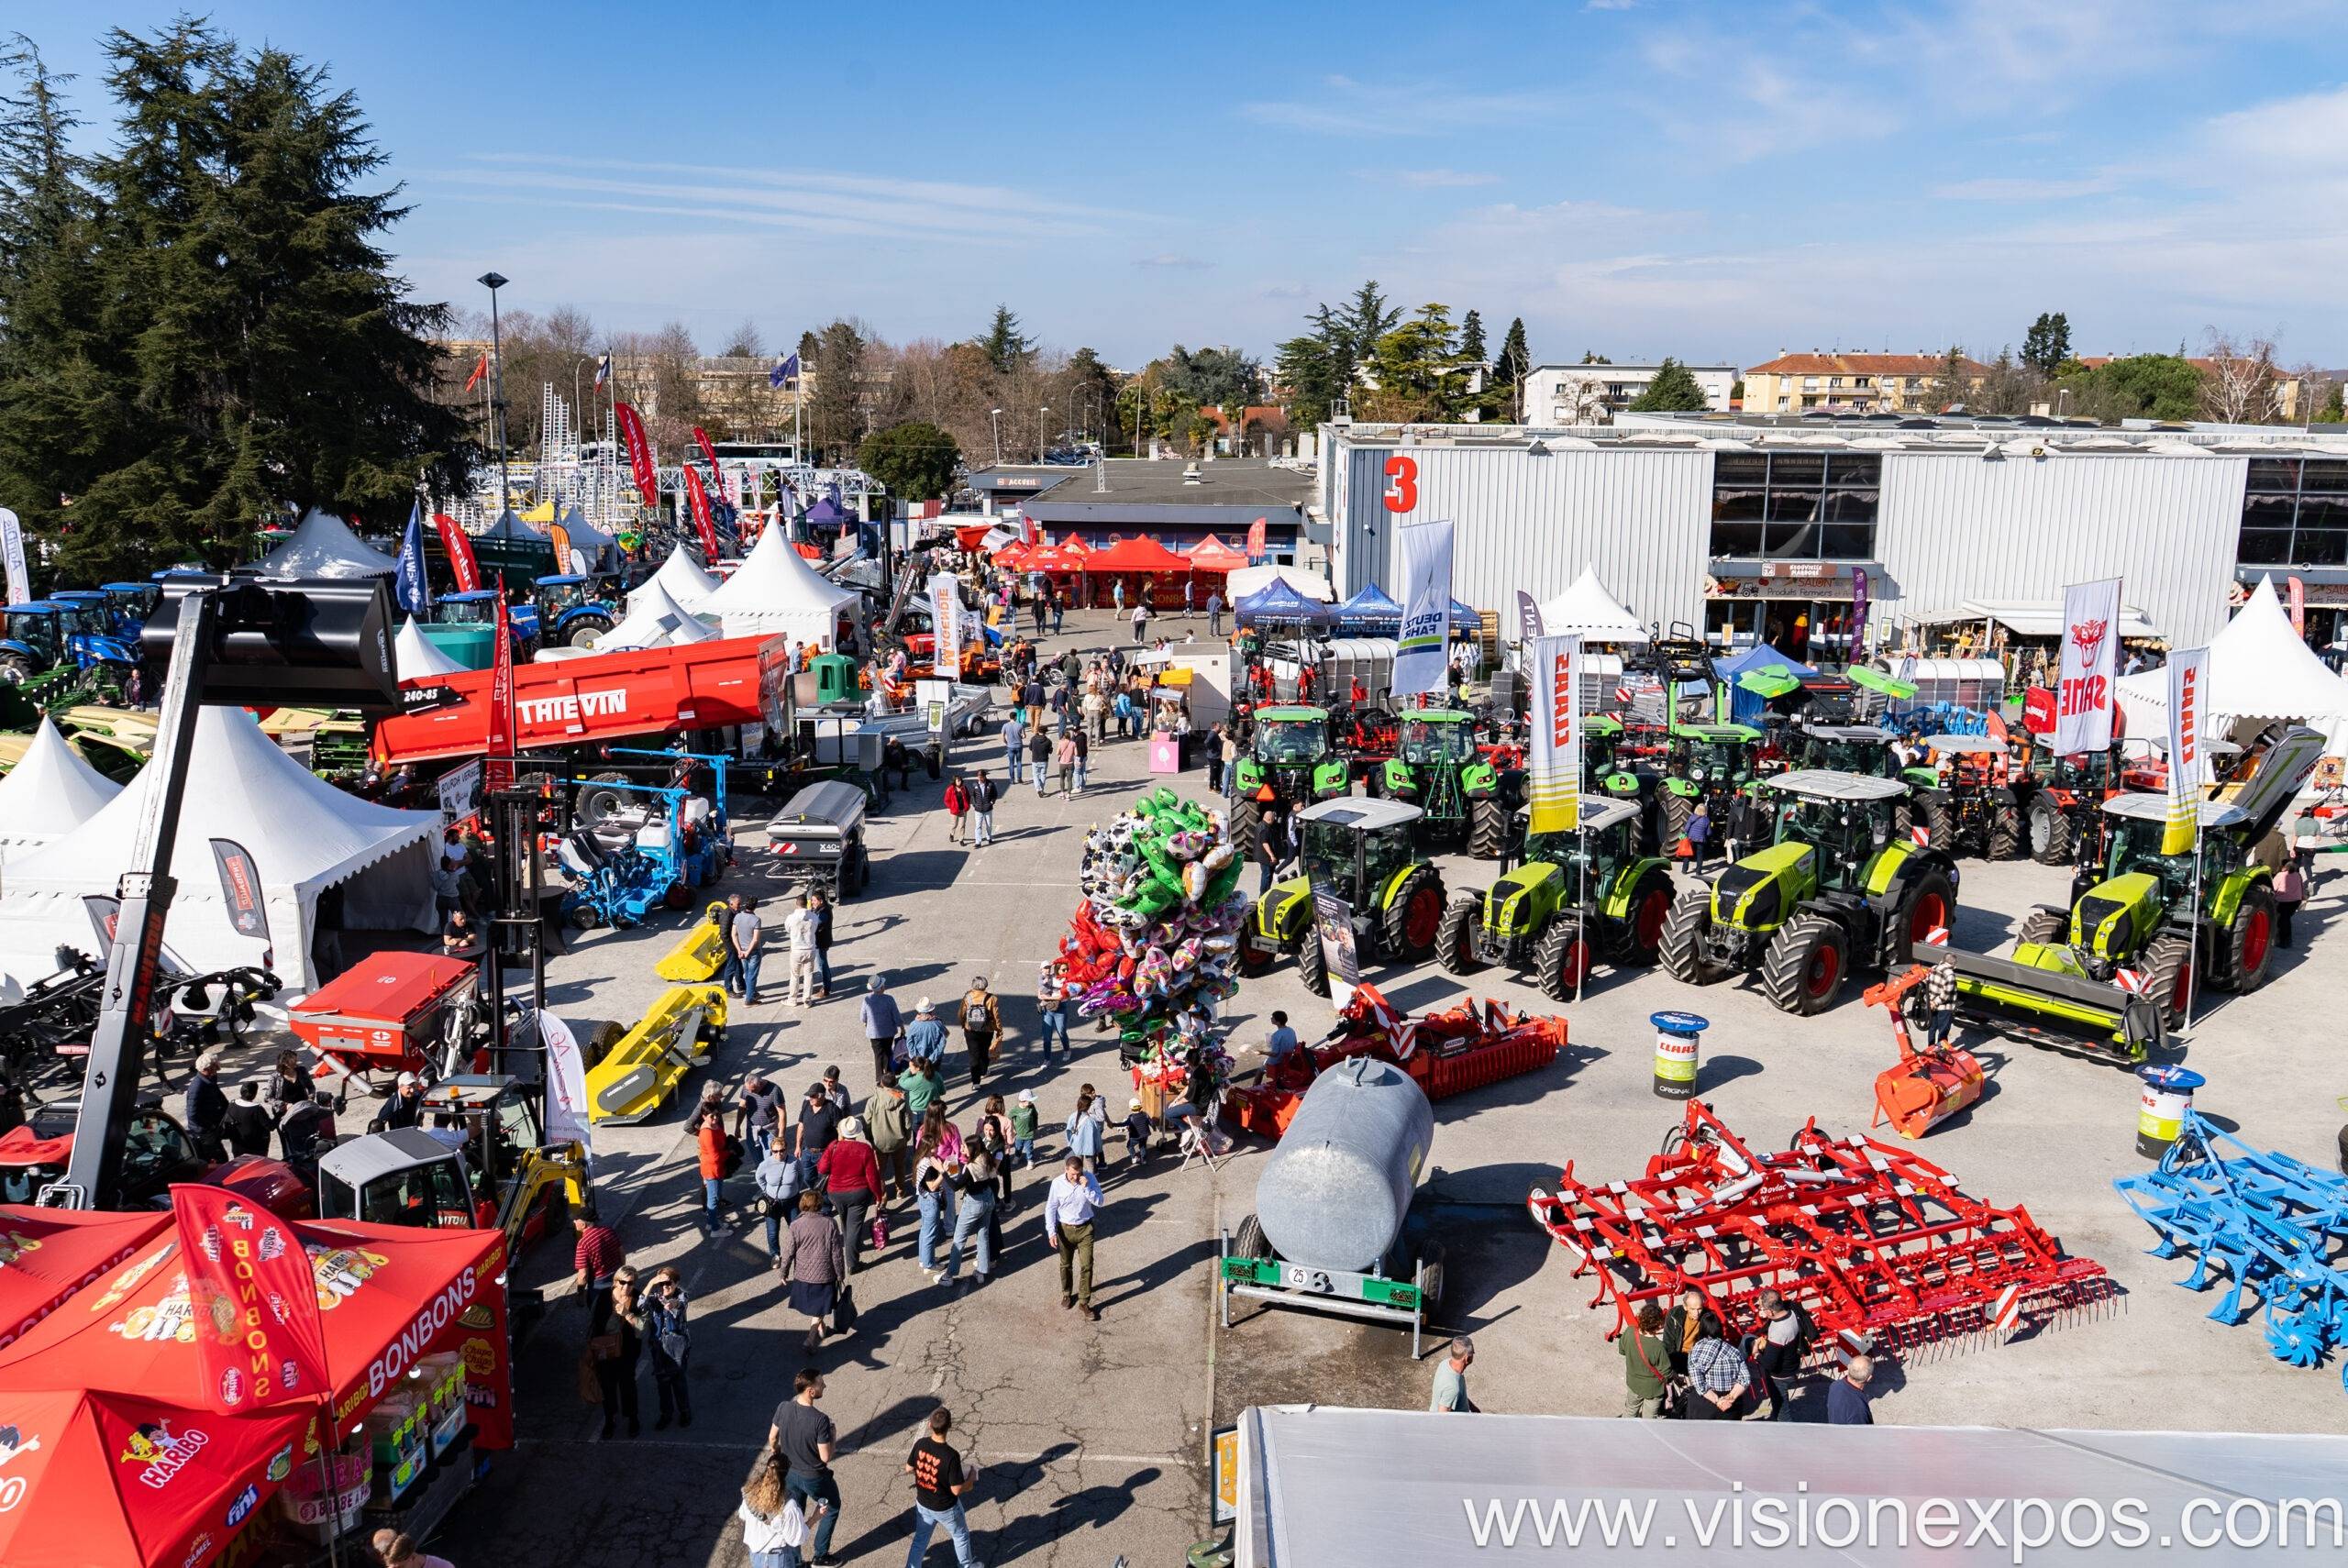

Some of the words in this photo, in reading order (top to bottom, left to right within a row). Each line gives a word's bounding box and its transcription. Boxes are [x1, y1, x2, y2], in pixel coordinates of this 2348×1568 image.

[1384, 457, 1418, 513] 3
[1767, 588, 1797, 596] Produits
[1798, 578, 1833, 588] SALON
[378, 633, 389, 673] MANITOU
[404, 689, 438, 702] 240-85
[515, 689, 627, 725] THIEVIN
[131, 912, 163, 1027] MANITOU
[1659, 1042, 1698, 1054] CLAAS
[1659, 1086, 1691, 1095] ORIGINAL
[320, 1253, 351, 1281] HARIBO
[476, 1248, 502, 1279] HARIBO
[1293, 1268, 1303, 1283] 25
[370, 1265, 475, 1397] BONBONS
[139, 1429, 210, 1489] HARIBO
[184, 1540, 213, 1568] DAMEL
